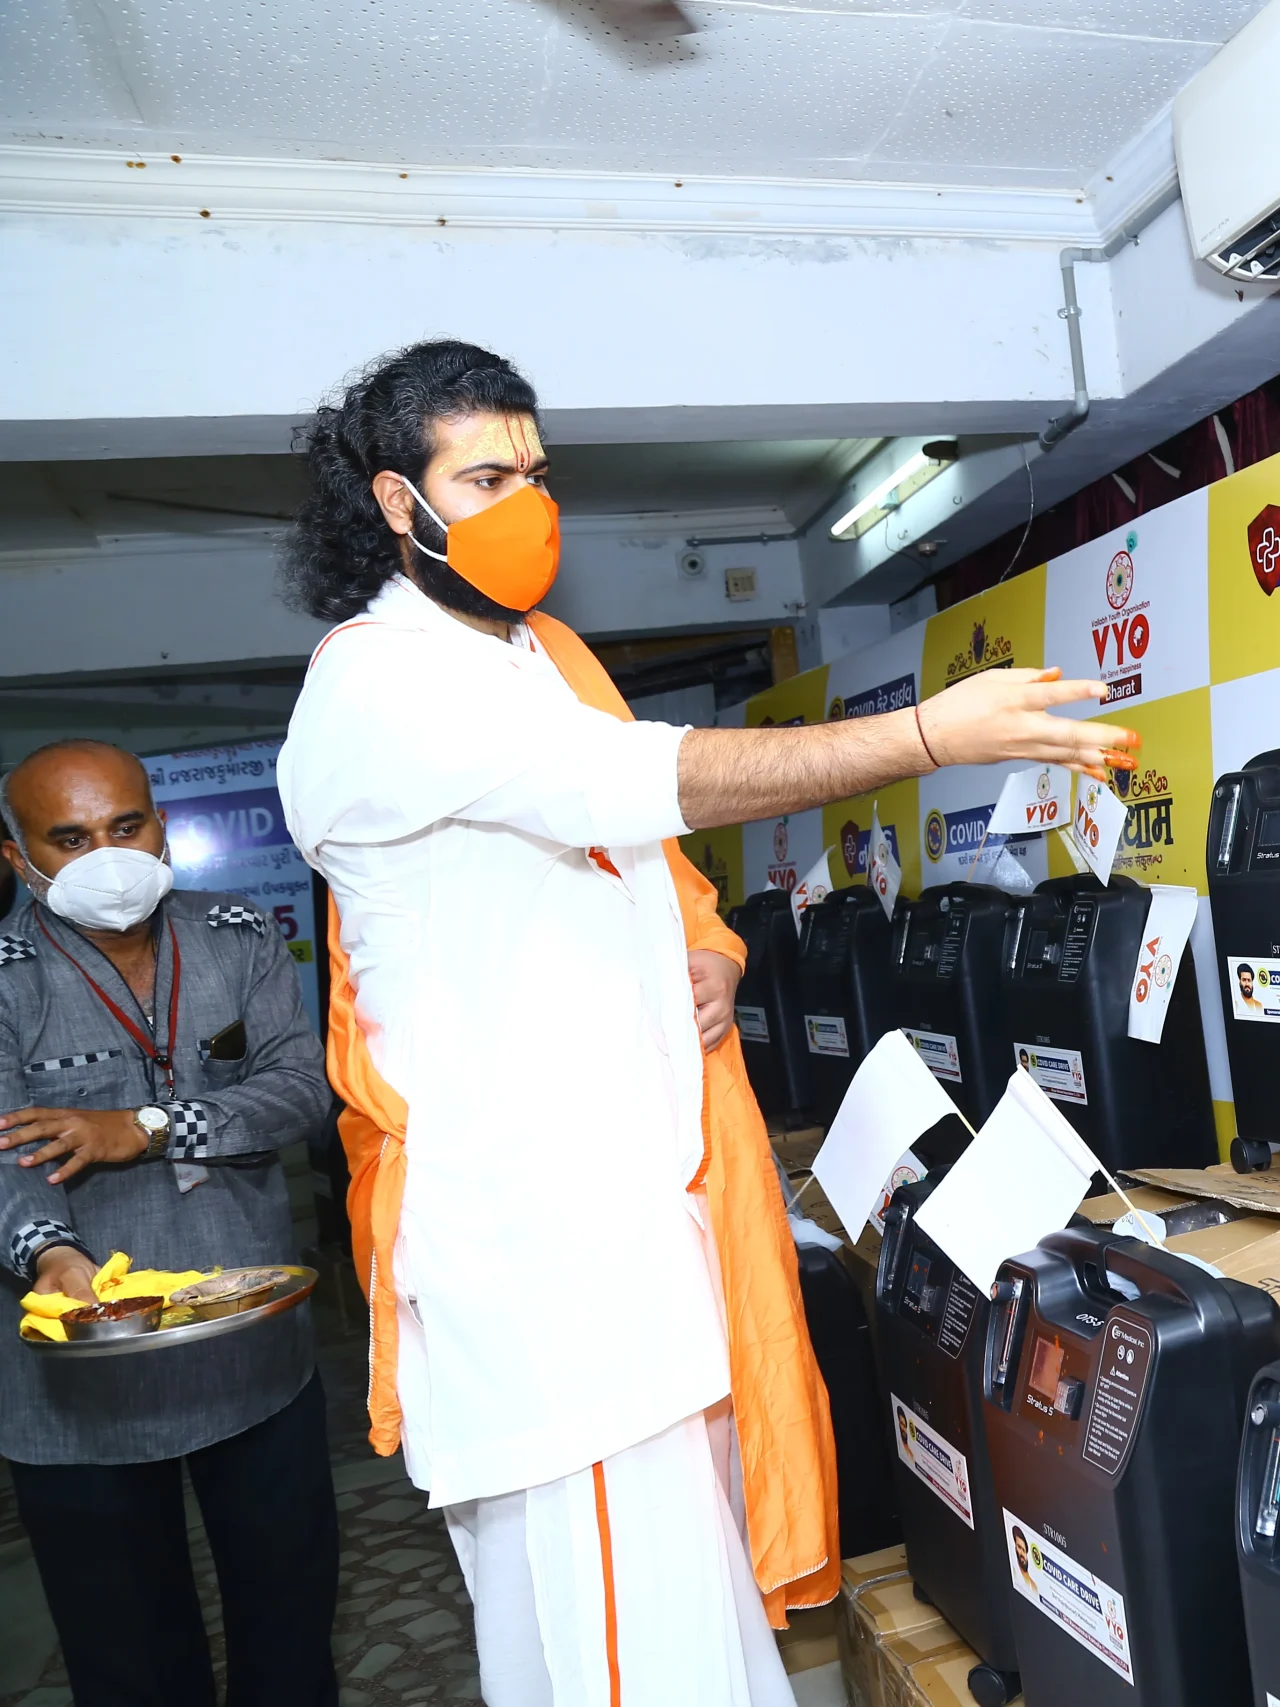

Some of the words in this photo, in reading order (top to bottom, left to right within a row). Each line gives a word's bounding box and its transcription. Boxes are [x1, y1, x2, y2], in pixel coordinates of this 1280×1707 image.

[1092, 613, 1149, 670] VYO
[1105, 679, 1136, 701] Bharat
[1026, 801, 1058, 825] VYO
[1078, 798, 1100, 848] VYO
[950, 815, 984, 846] COVID
[1256, 851, 1279, 859] Stratus
[1136, 936, 1161, 1003] VYO
[1027, 1394, 1048, 1413] Stratus
[916, 1432, 929, 1449] COVID
[928, 1442, 940, 1458] CARE
[940, 1451, 952, 1470] DRIVE
[1043, 1559, 1062, 1580] COVID
[1062, 1574, 1080, 1594] CARE
[1080, 1587, 1100, 1610] DRIVE
[1105, 1616, 1124, 1640] VYO
